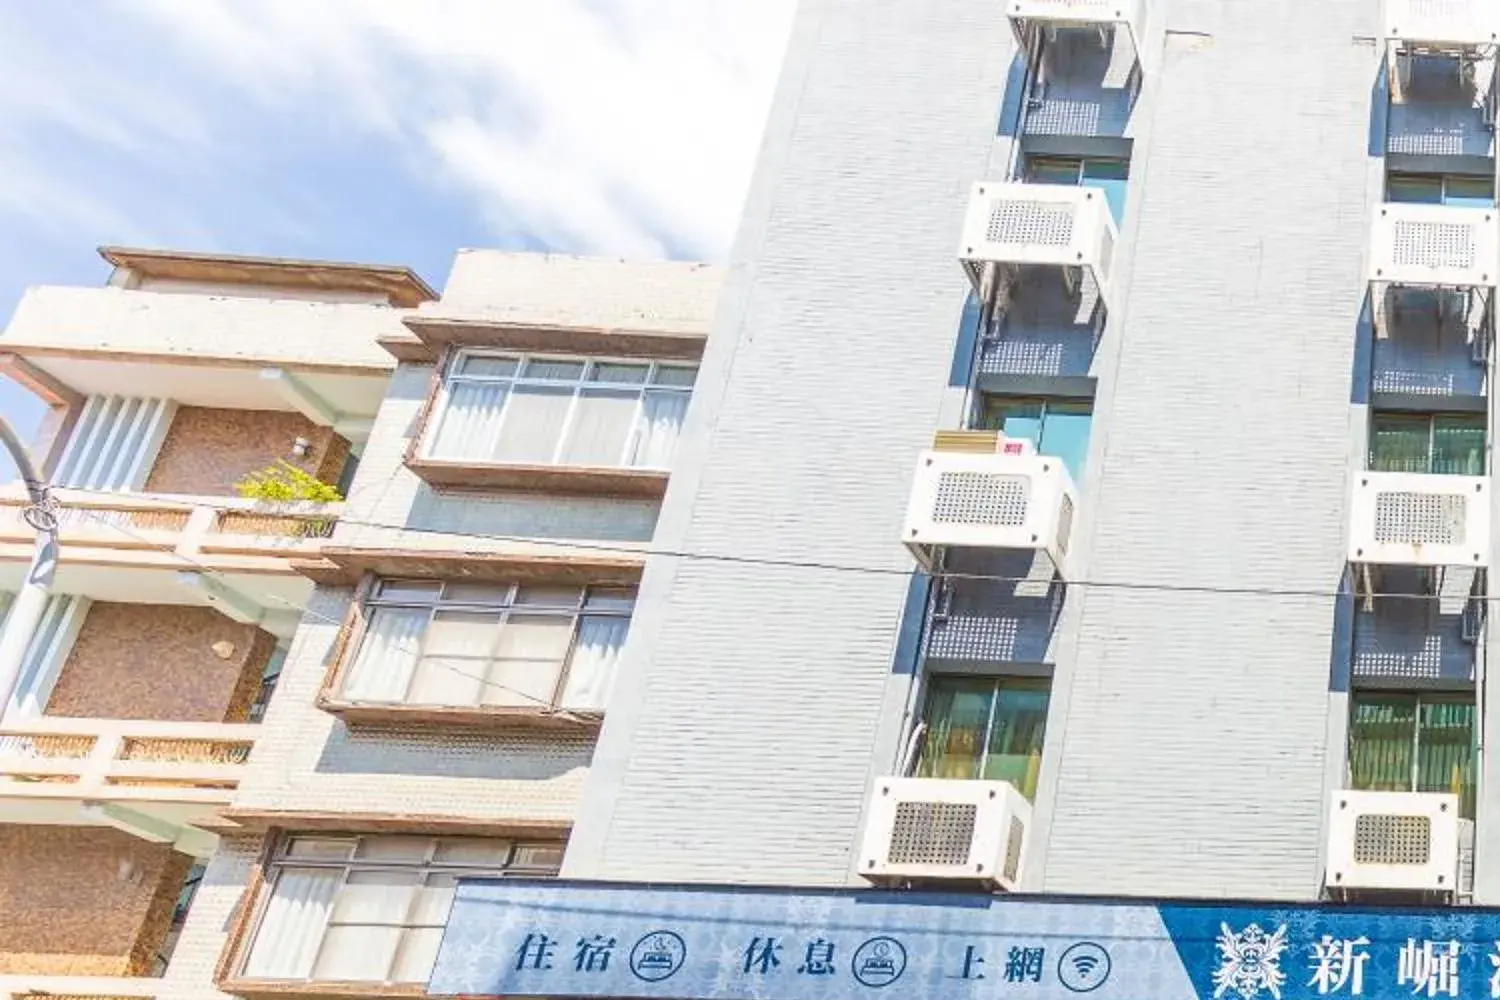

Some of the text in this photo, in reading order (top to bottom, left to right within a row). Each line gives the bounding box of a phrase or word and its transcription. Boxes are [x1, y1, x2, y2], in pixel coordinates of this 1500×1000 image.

[514, 931, 617, 971] 住宿
[742, 936, 836, 976] 休息
[943, 945, 1045, 984] 上網
